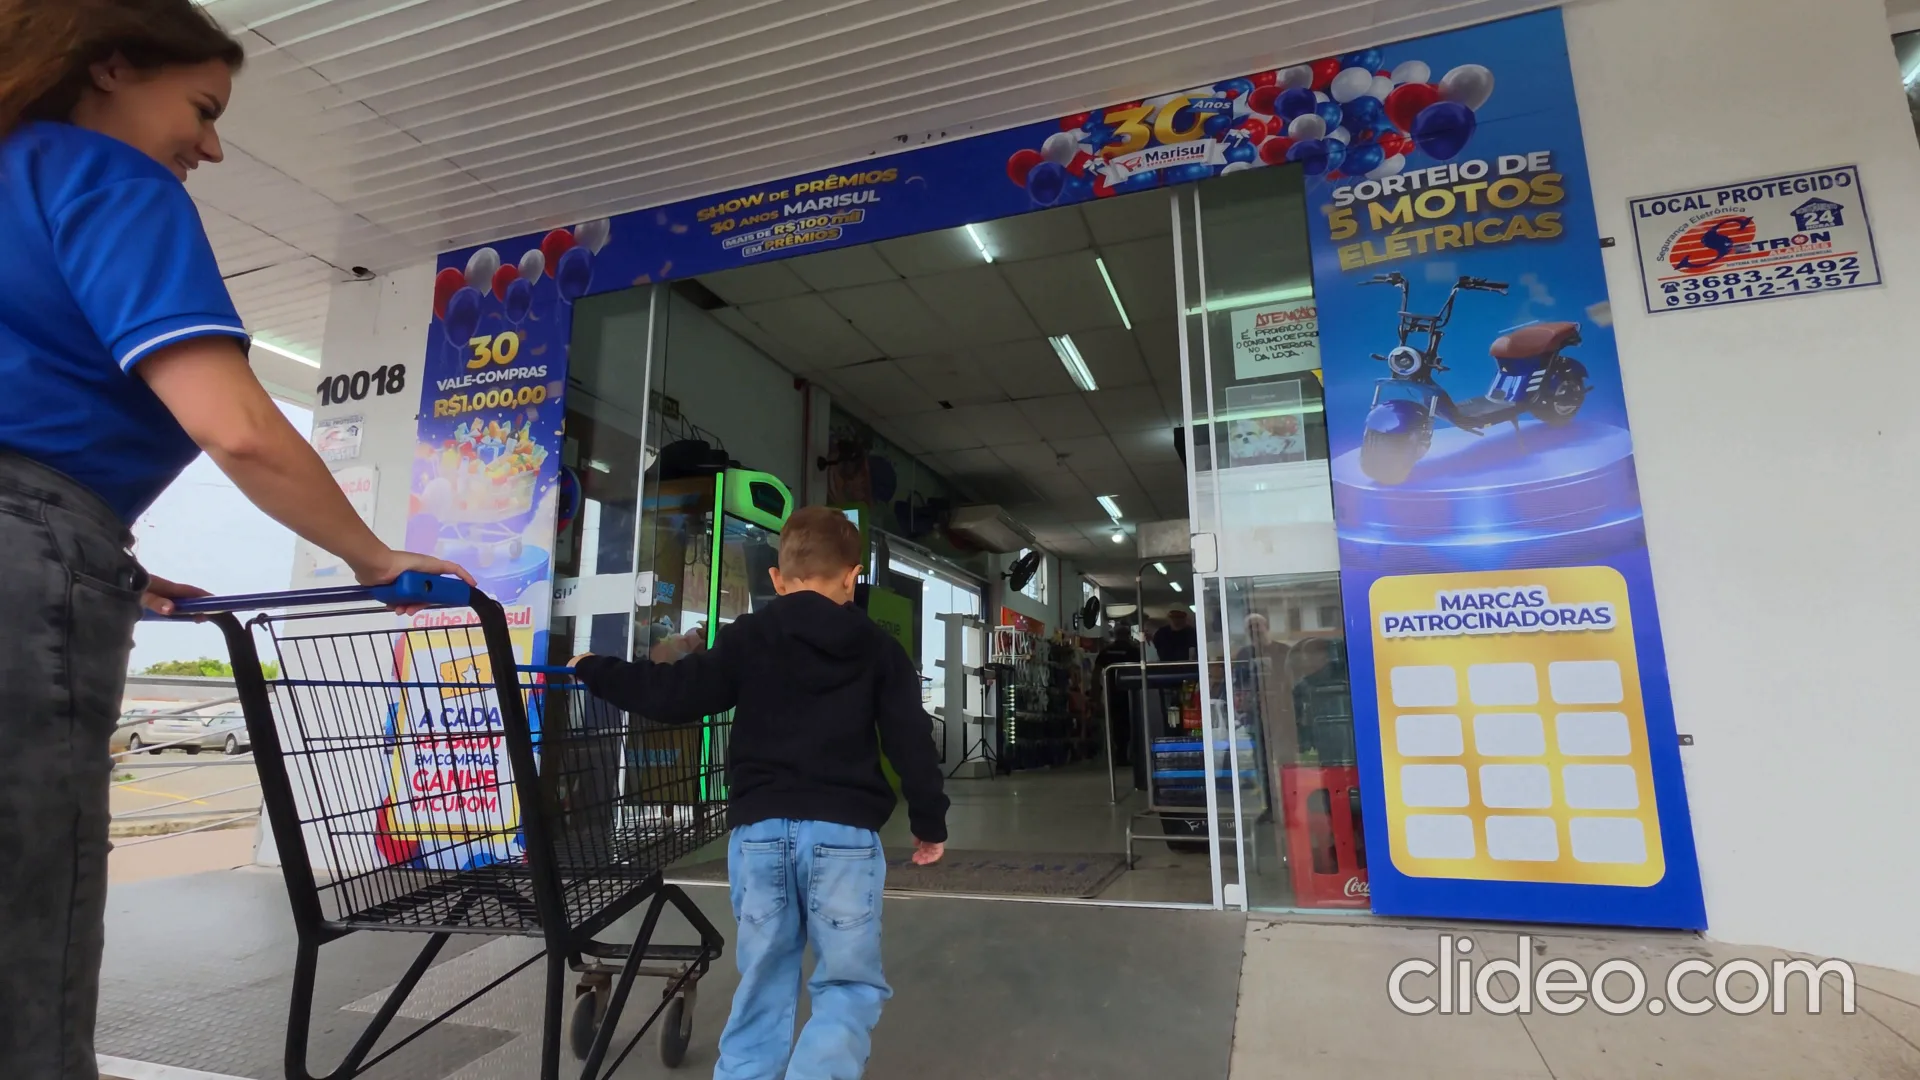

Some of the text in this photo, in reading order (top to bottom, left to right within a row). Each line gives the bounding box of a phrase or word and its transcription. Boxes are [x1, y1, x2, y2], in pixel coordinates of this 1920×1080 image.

[1193, 99, 1232, 110] Anos
[1100, 92, 1214, 158] 30
[1145, 143, 1205, 163] Marisul
[1332, 150, 1551, 208] SORTEIO DE
[696, 168, 898, 222] SHOW DE PRÊMIOS
[1328, 172, 1565, 241] 5 MOTOS
[1639, 171, 1852, 218] LOCAL PROTEGIDO
[711, 190, 881, 235] 30 ANOS MARISUL
[1803, 210, 1835, 226] 24
[725, 233, 755, 248] MAIS
[756, 230, 771, 240] DE
[773, 221, 796, 236] R$
[799, 215, 829, 231] 100
[745, 227, 841, 255] EM PRÊMIOS
[1337, 212, 1563, 271] ELÉTRICAS
[1656, 206, 1746, 262] Segurança Eletrônica
[1682, 257, 1860, 291] 3683.2492
[1685, 271, 1861, 306] 99112-1357
[1255, 306, 1317, 327] ATENÇÃO
[1241, 329, 1250, 340] É
[1306, 322, 1314, 330] O
[1243, 335, 1282, 348] CONSUMO
[1283, 332, 1296, 341] DE
[1297, 330, 1319, 339] PRO
[466, 331, 521, 370] 30
[1266, 340, 1315, 352] INTERIOR
[316, 363, 406, 406] 10018
[436, 364, 548, 392] VALE-COMPRAS
[433, 385, 547, 418] R$1.000,00
[1440, 590, 1544, 611] MARCAS
[413, 612, 461, 628] Clube
[1384, 606, 1611, 633] PATROCINADORAS
[418, 707, 502, 728] A CADA
[414, 753, 499, 766] EM COMPRAS
[412, 769, 498, 793] GANHE
[430, 796, 497, 813] CUPOM
